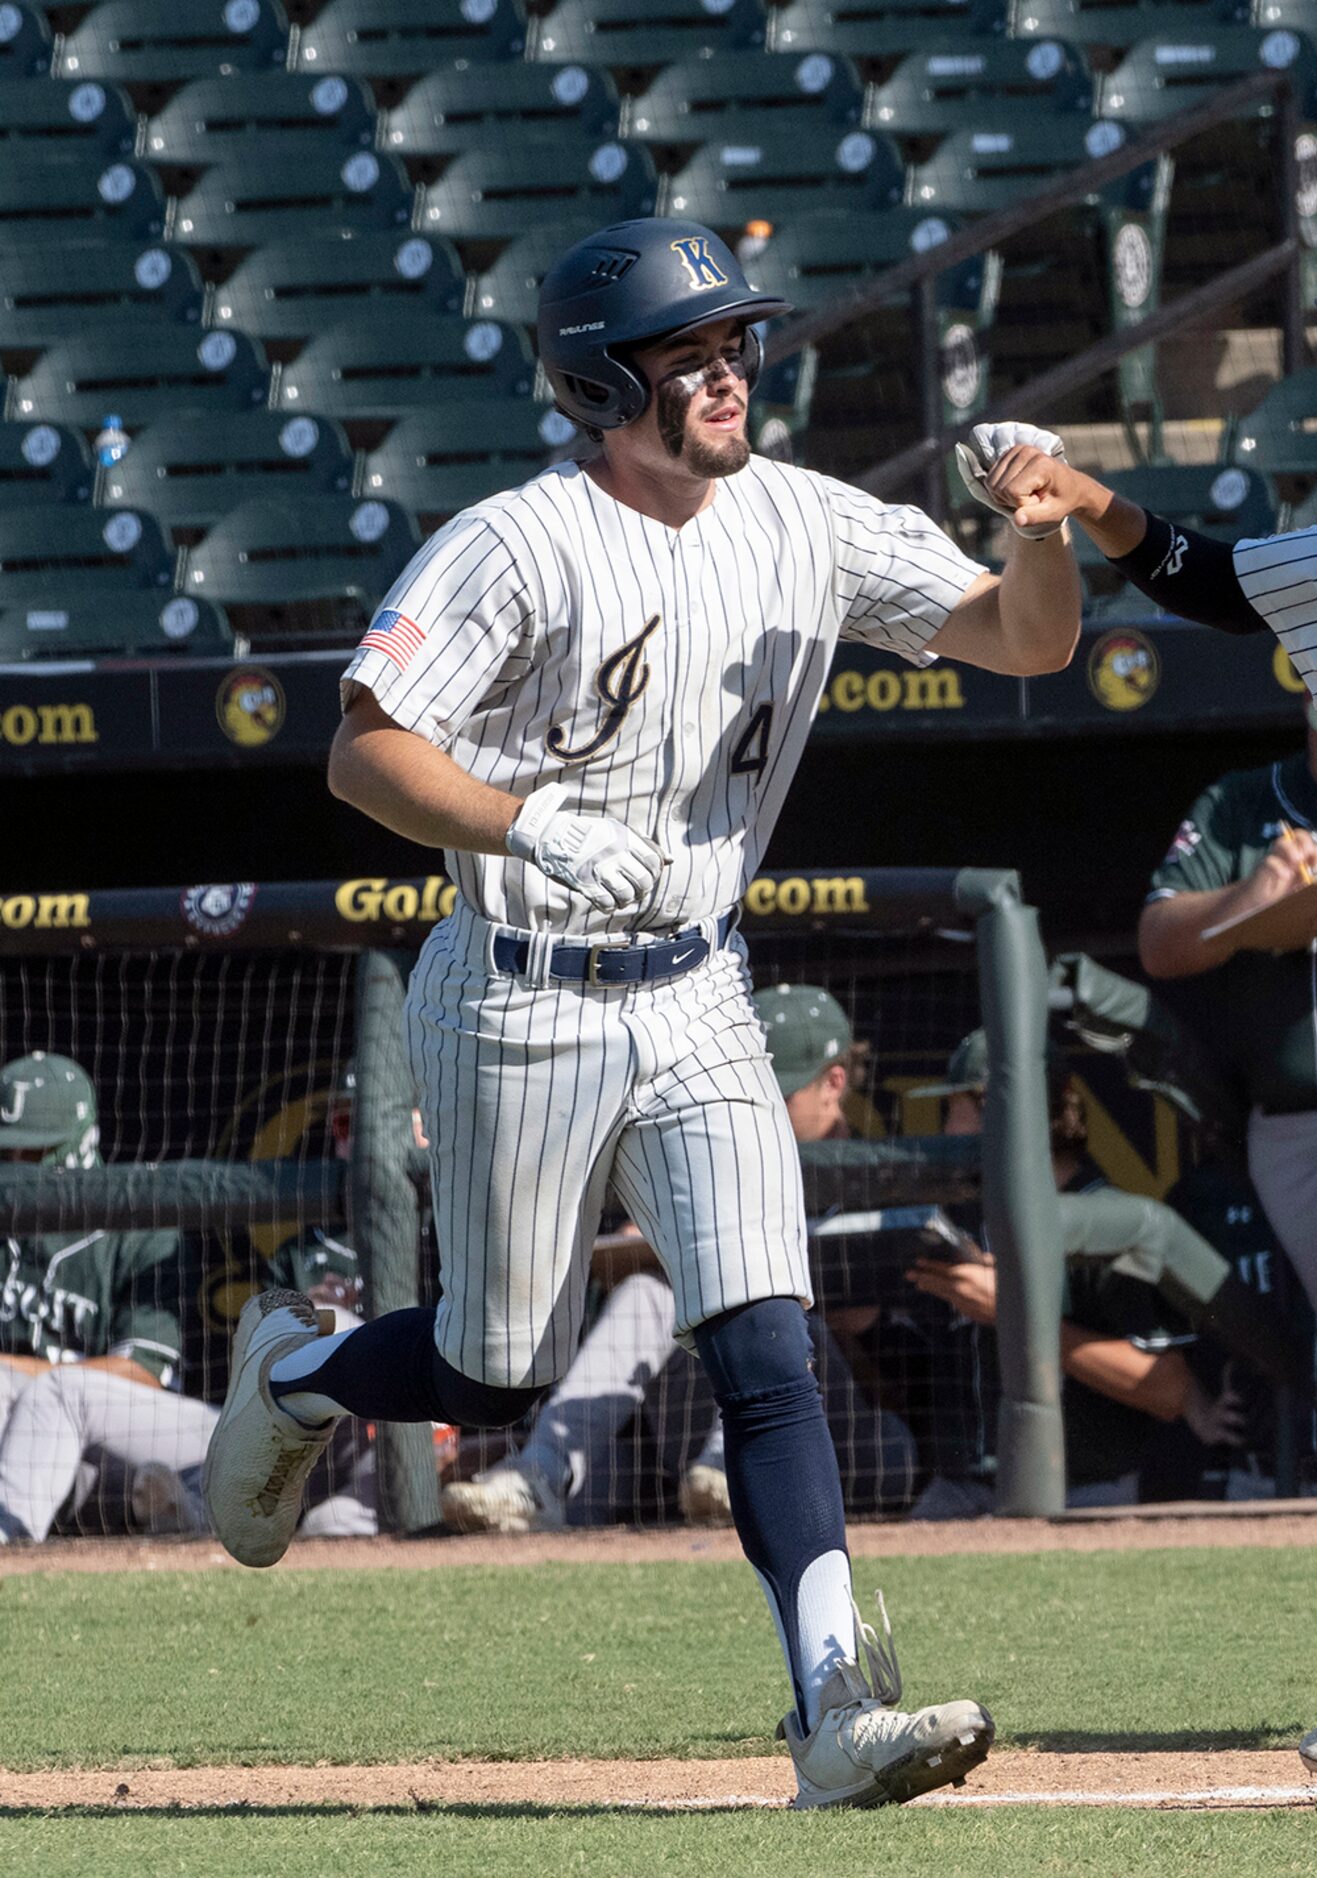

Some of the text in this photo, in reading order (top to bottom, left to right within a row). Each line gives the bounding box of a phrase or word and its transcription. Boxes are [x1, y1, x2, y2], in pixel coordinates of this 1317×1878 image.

[670, 236, 728, 291] K
[0, 703, 99, 746] om
[729, 700, 776, 790] 4
[0, 893, 92, 929] om
